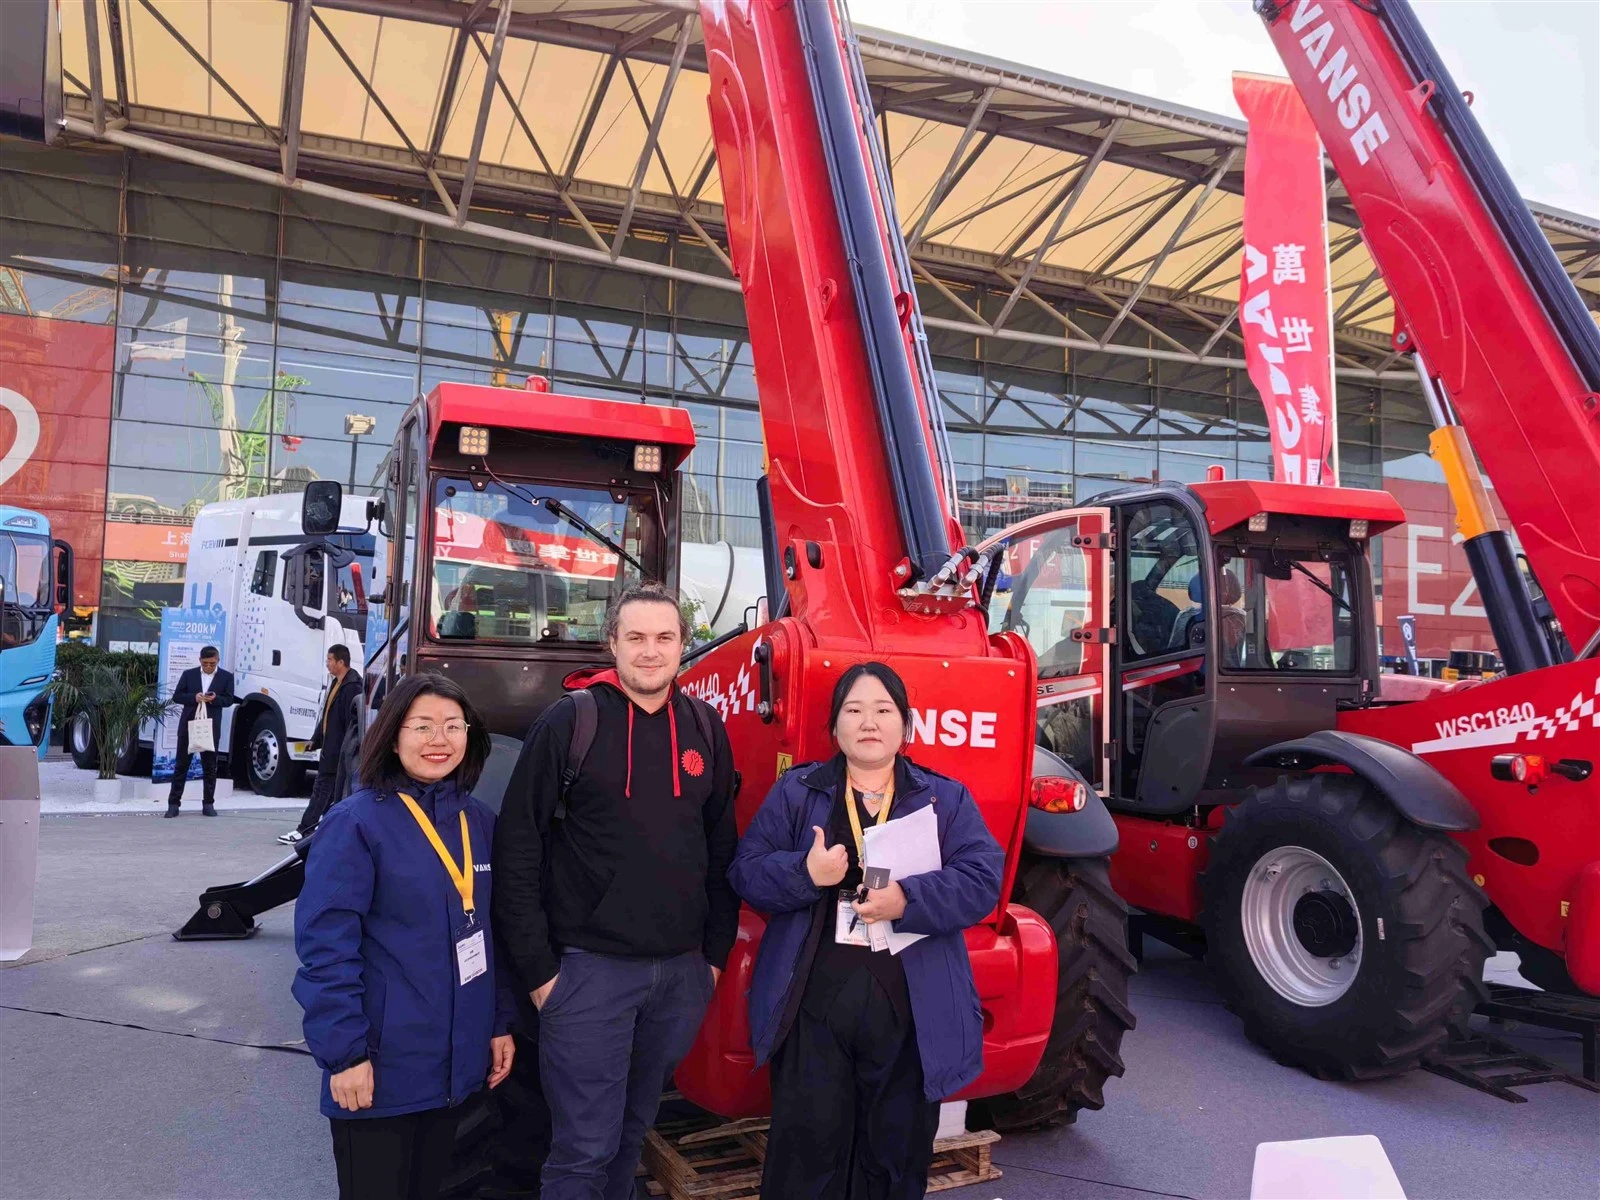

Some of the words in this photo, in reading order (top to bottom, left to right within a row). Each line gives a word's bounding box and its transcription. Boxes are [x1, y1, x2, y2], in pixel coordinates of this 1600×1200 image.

[1290, 0, 1390, 166] VANSE
[910, 708, 997, 749] NSE
[1435, 701, 1536, 739] WSC1840
